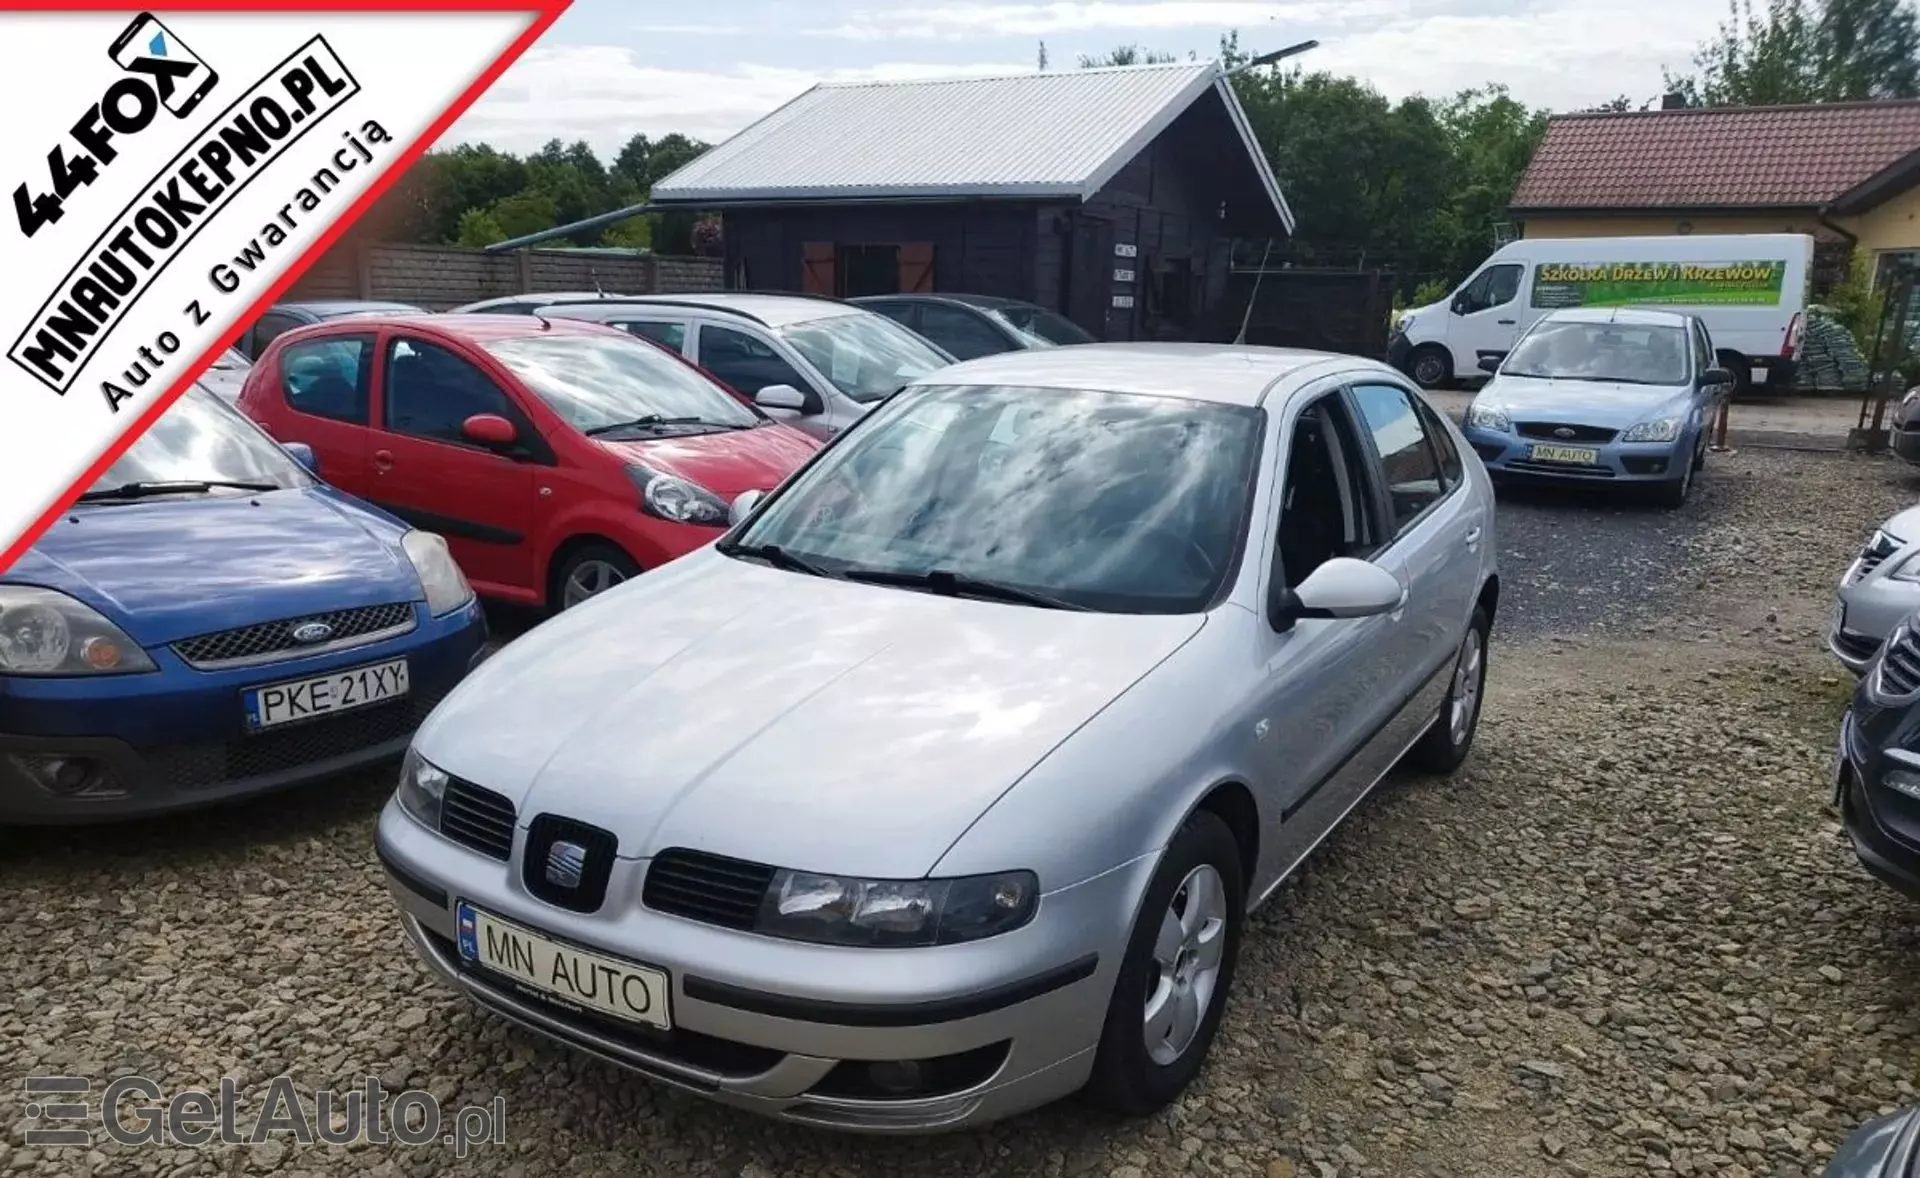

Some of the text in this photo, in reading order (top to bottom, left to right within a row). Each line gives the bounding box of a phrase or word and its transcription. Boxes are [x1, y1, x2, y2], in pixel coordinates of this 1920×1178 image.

[1612, 267, 1669, 281] DRZEW
[1560, 449, 1592, 461] AUTO
[264, 663, 402, 721] PKE 21XY
[486, 924, 535, 977] MN
[551, 952, 651, 1014] AUTO
